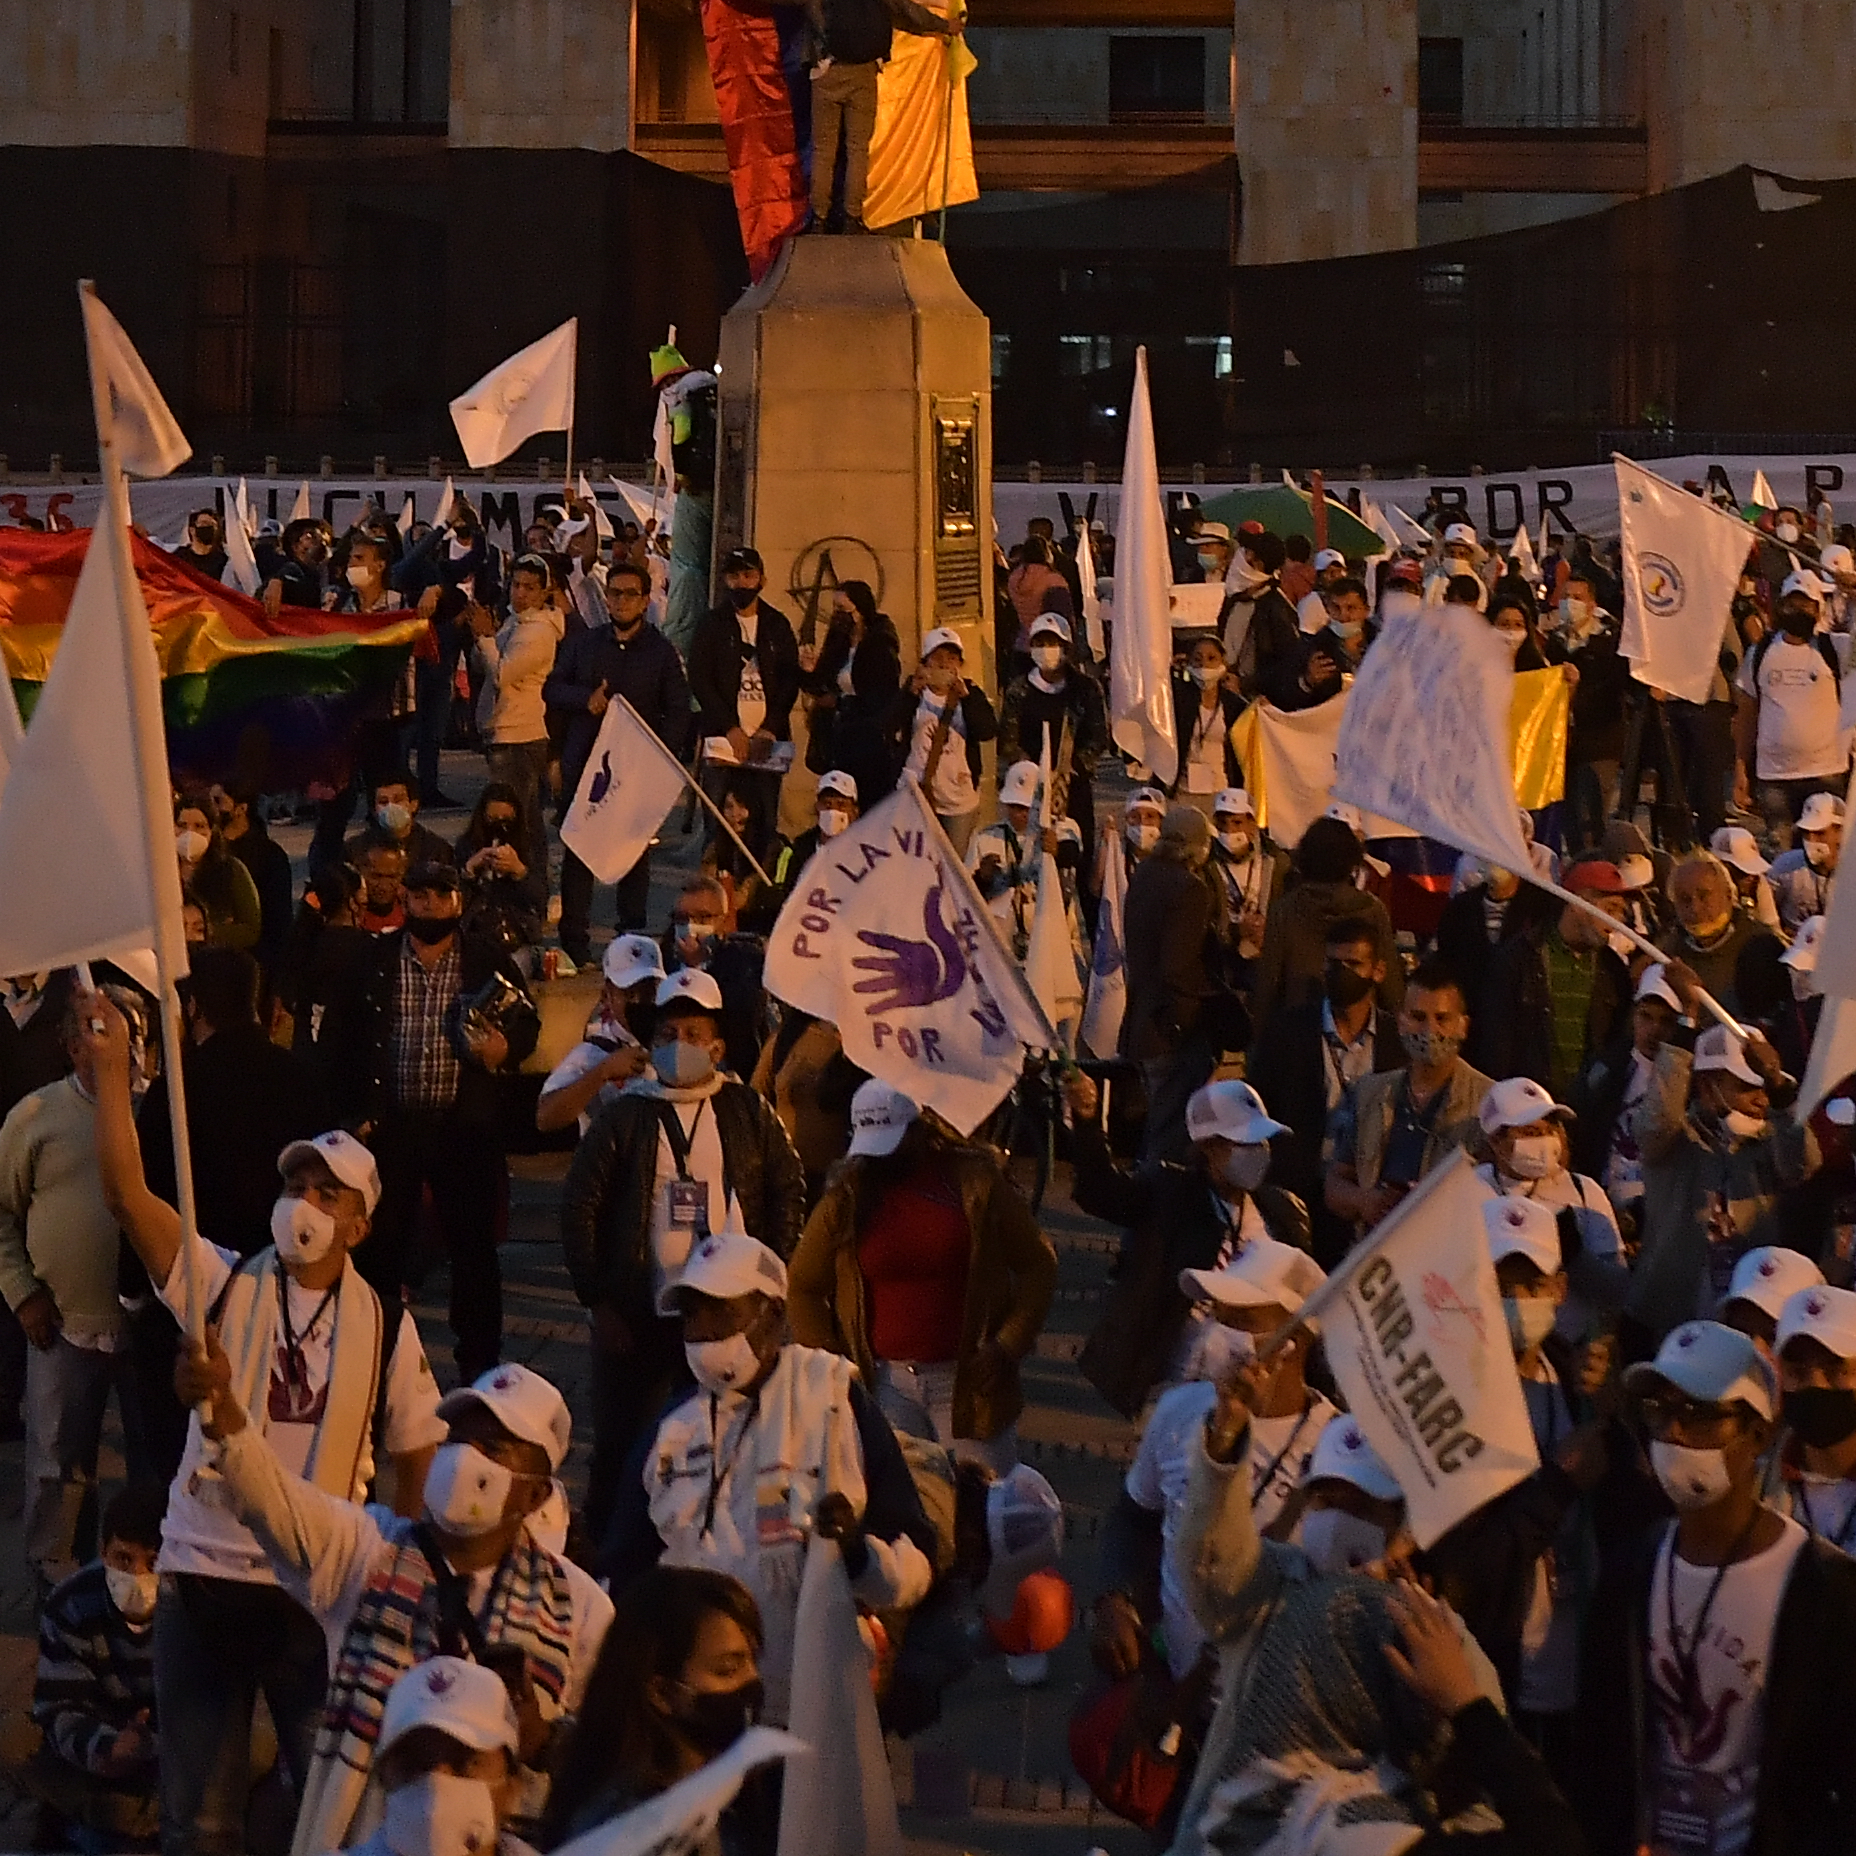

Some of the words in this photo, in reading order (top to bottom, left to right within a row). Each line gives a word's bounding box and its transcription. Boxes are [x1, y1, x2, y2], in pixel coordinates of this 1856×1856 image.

[1430, 480, 1577, 540] POR
[792, 887, 842, 959] POR
[835, 843, 892, 884] LA
[872, 1021, 945, 1063] POR
[1356, 1256, 1485, 1474] CNR-FARC
